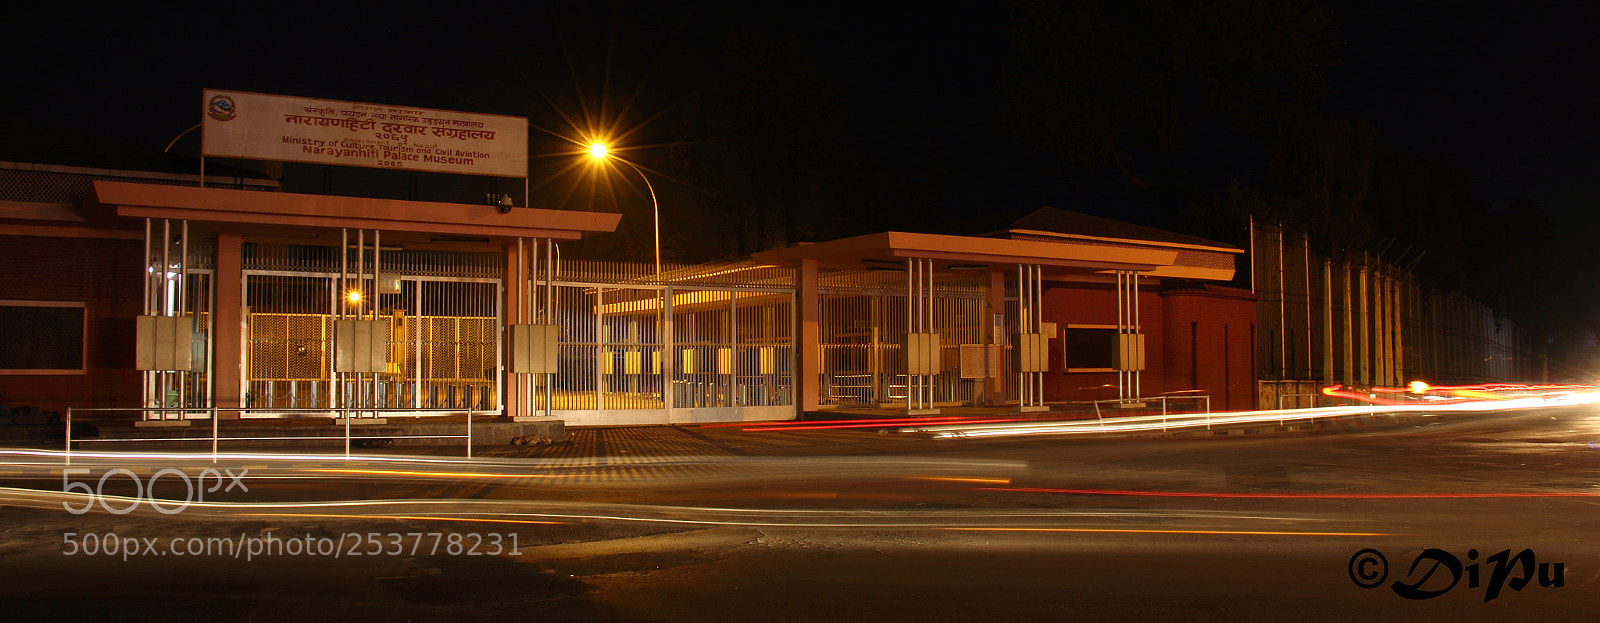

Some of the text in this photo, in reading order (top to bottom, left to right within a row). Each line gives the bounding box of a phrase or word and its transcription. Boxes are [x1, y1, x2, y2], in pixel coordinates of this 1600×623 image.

[371, 112, 387, 120] तथा
[375, 132, 408, 143] २०६५
[282, 136, 490, 159] Ministry of Culture Tourism and Civil Aviation
[302, 145, 474, 165] Narayanhiti Palace Museum
